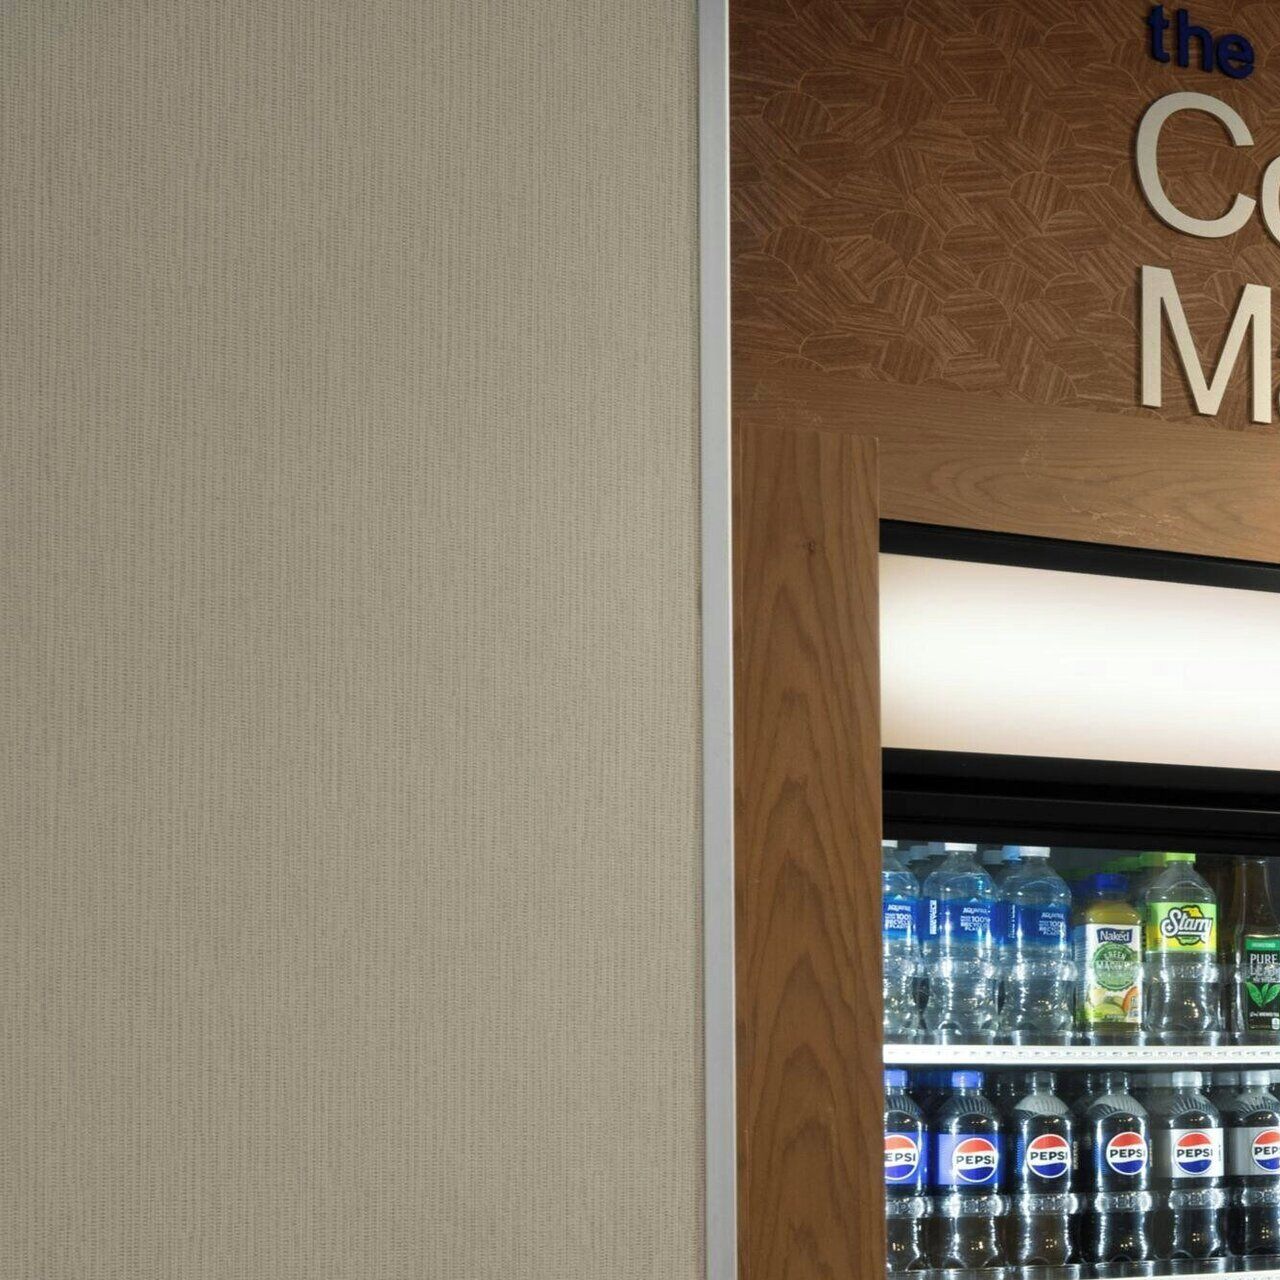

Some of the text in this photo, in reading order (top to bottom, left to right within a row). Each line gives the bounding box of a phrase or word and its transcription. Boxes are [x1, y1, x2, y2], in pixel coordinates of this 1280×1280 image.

[1145, 4, 1255, 79] the
[1099, 930, 1131, 942] Naked
[1249, 953, 1278, 965] PURE
[1029, 1150, 1069, 1162] PEPSI
[1108, 1148, 1146, 1160] PEPSI
[1175, 1148, 1215, 1160] PEPSI
[955, 1154, 997, 1167] PEPSI
